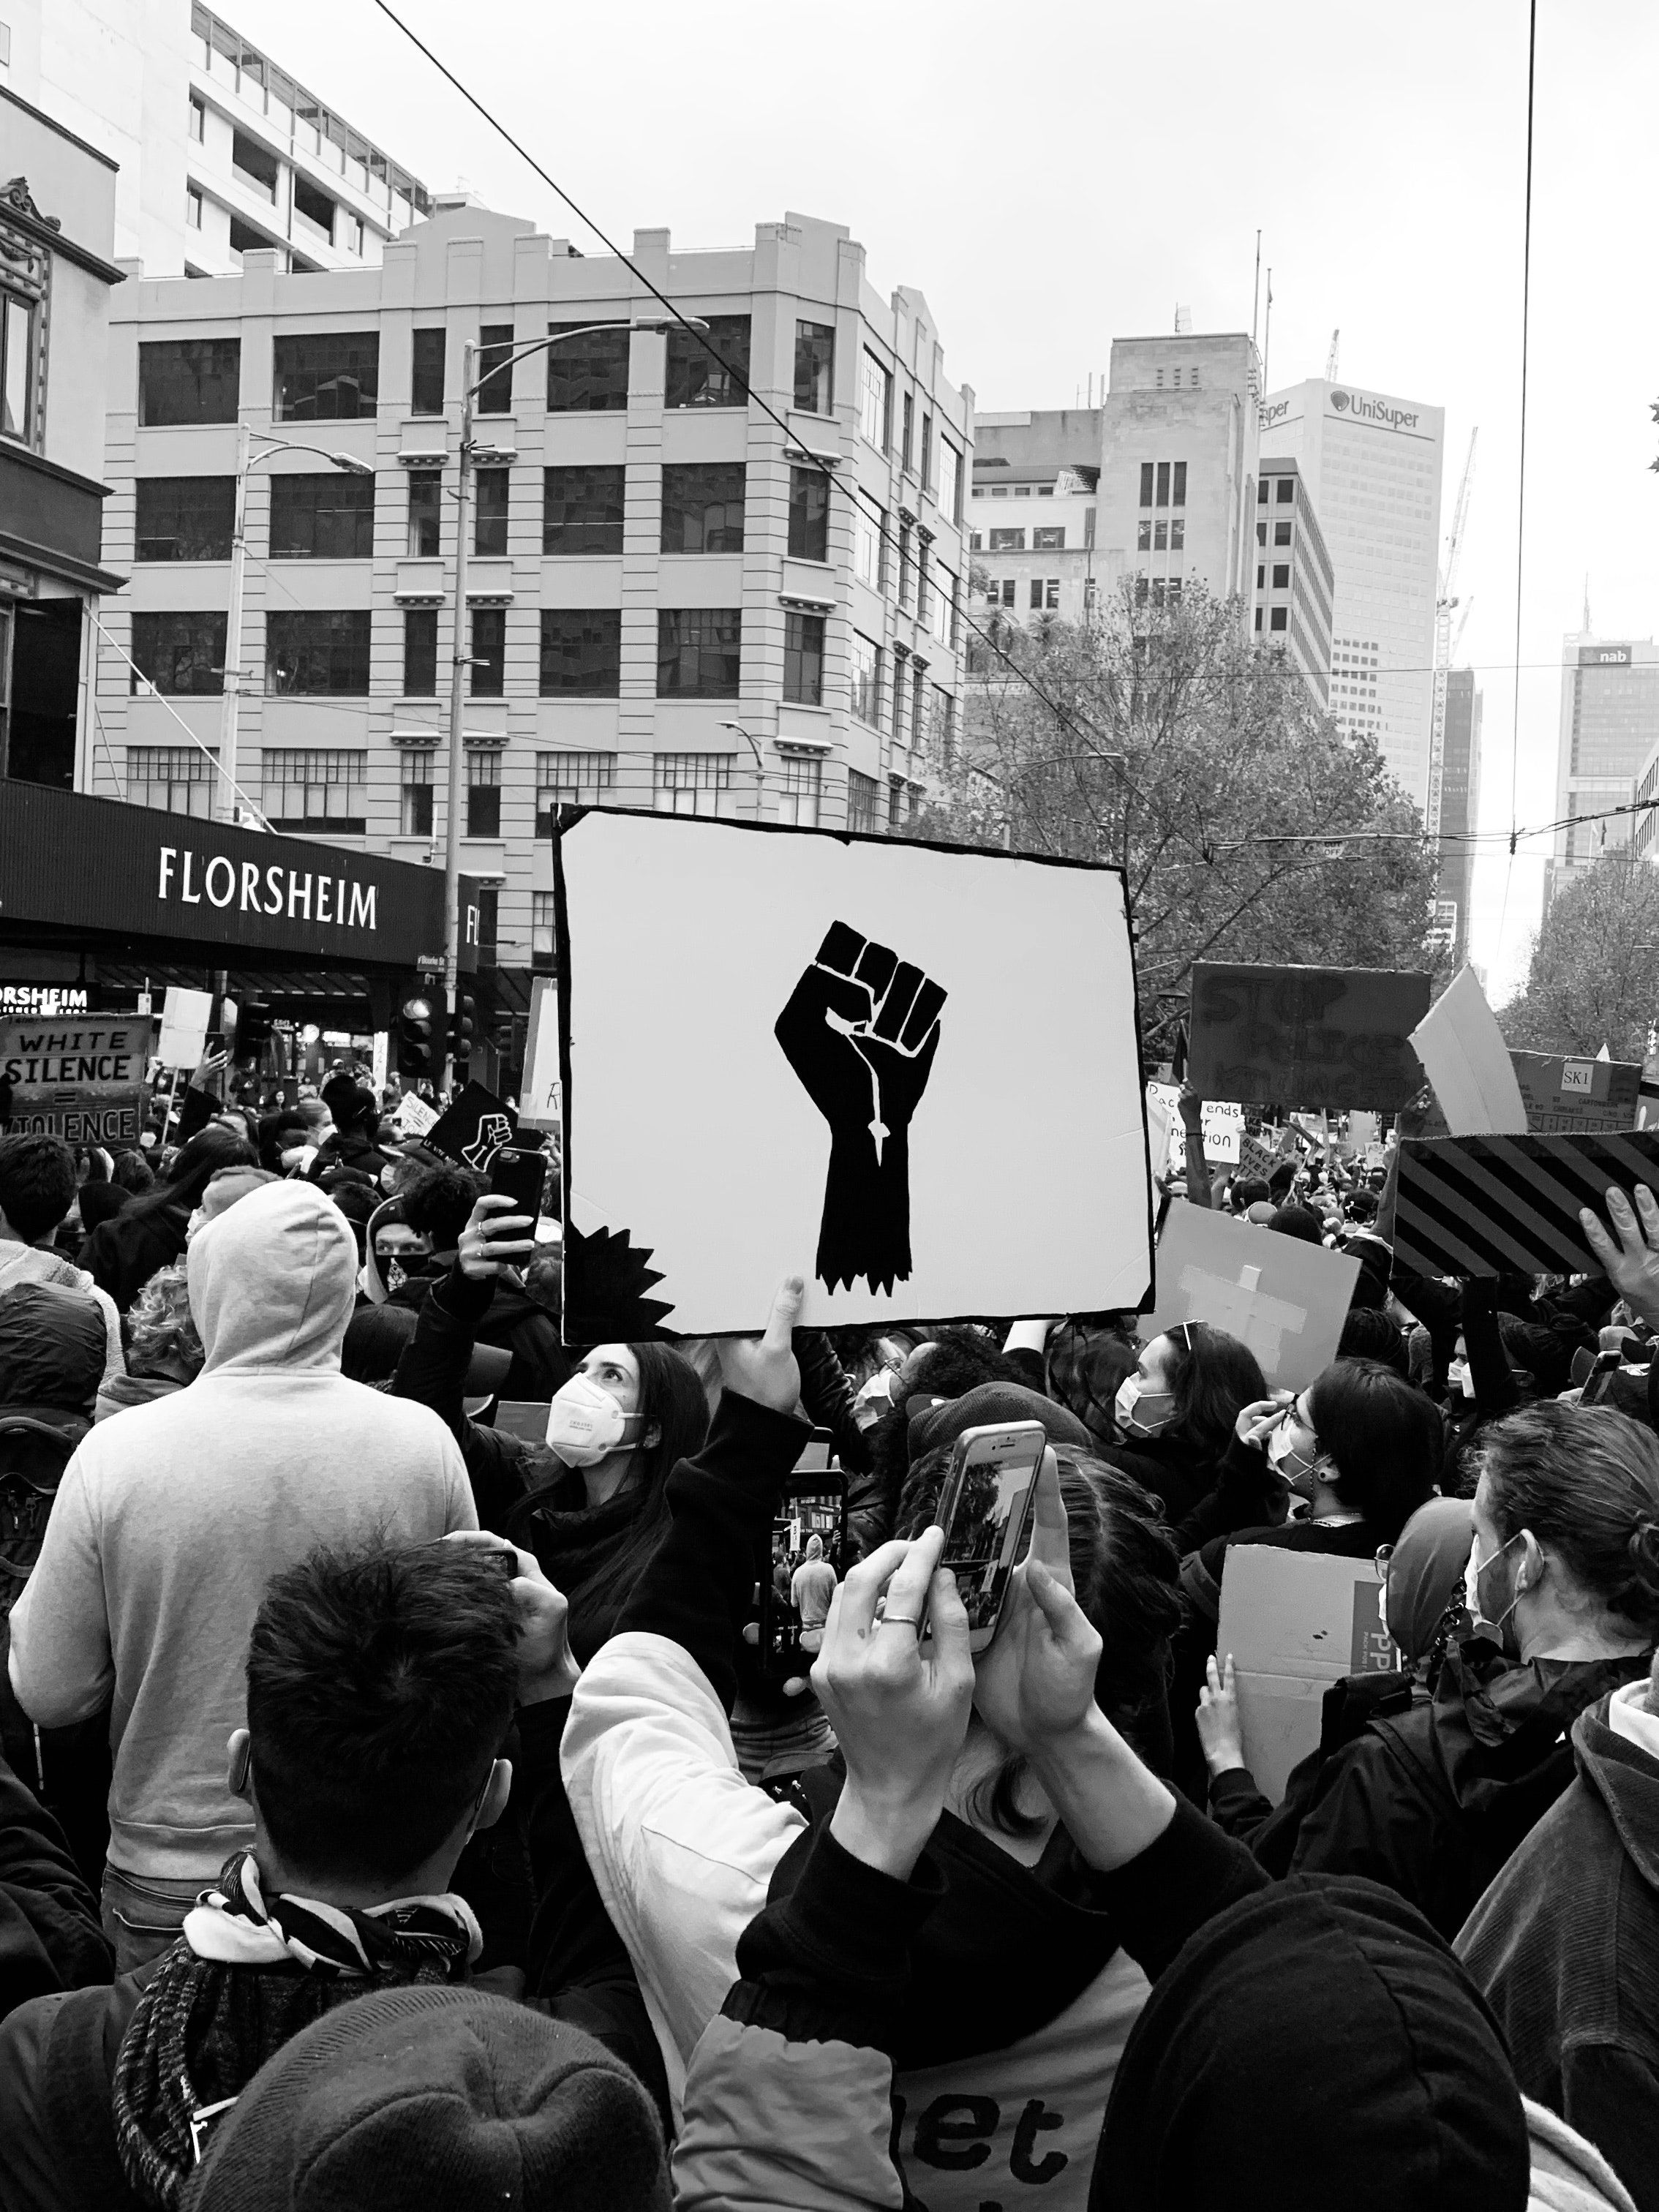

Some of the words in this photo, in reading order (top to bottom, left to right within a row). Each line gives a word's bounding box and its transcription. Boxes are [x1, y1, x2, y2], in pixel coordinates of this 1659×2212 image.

[1351, 394, 1419, 429] UniSuper
[1600, 650, 1627, 662] nab
[158, 846, 377, 930] FLORSHEIM
[0, 986, 87, 1008] RSHEIM
[20, 1031, 128, 1052] WHITE
[5, 1055, 132, 1085] SILENCE
[1206, 1105, 1238, 1118] ends
[1243, 1138, 1277, 1167] BLACK
